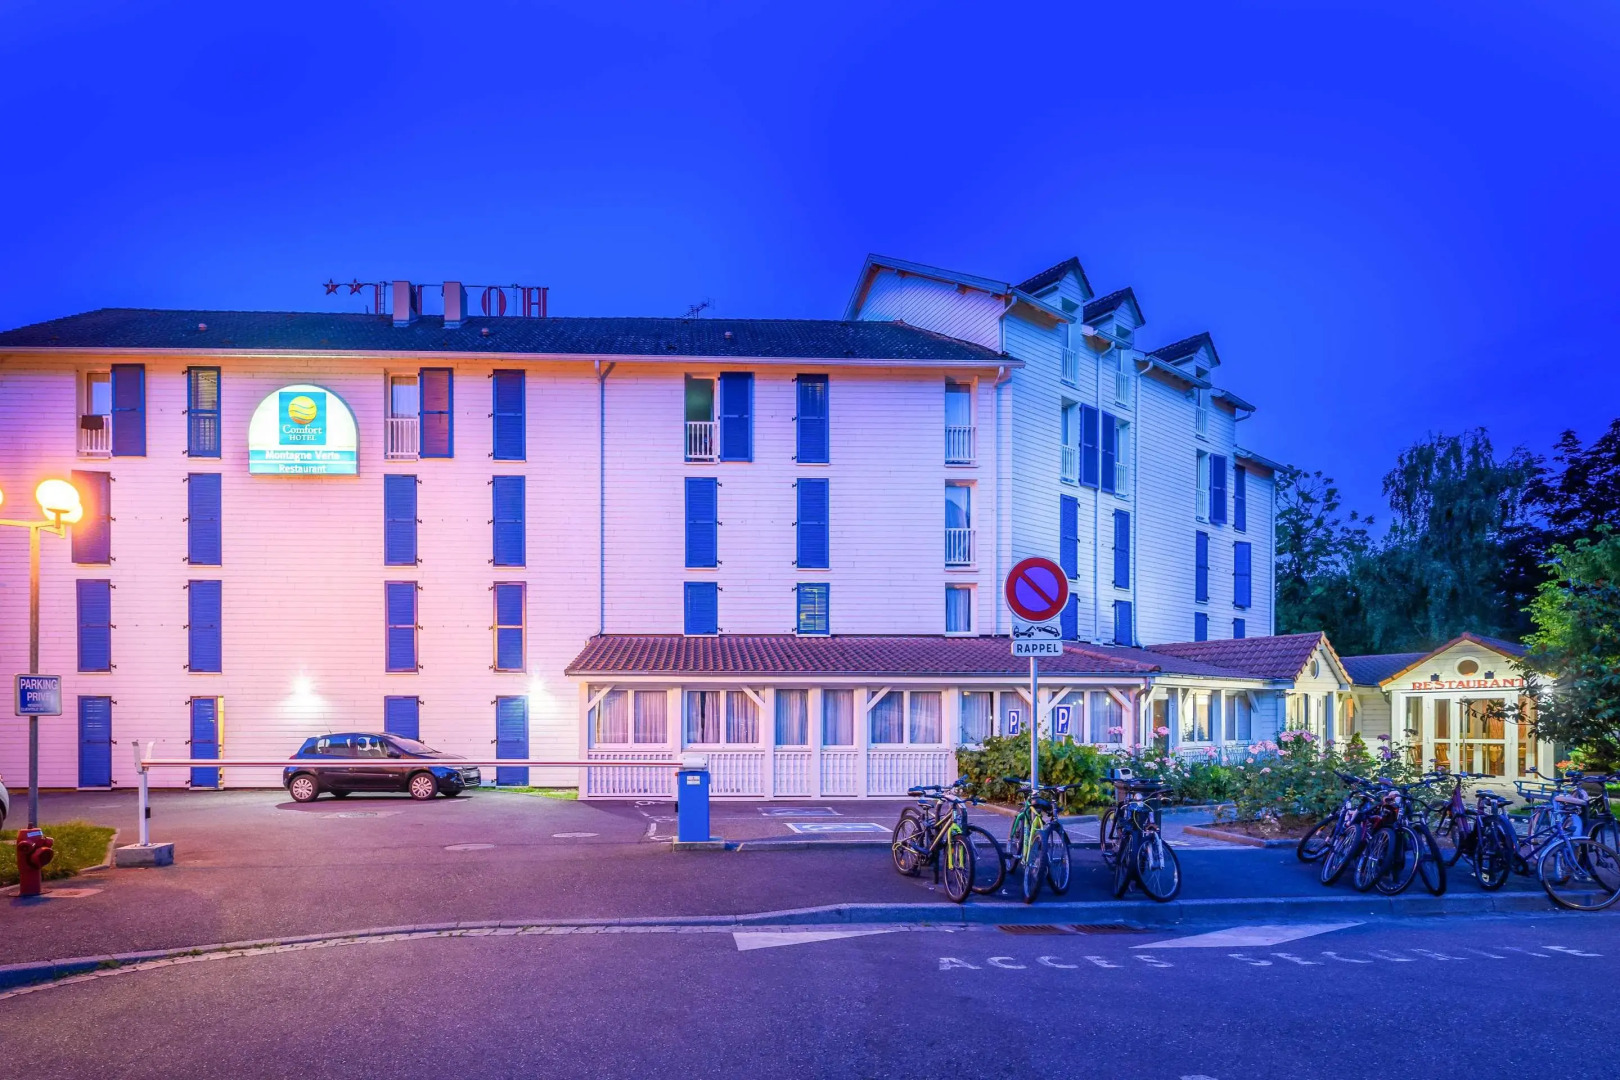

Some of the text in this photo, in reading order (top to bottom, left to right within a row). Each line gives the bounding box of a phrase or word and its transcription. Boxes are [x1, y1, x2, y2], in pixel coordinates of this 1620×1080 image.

[282, 424, 323, 434] Comfort
[265, 450, 340, 462] Montagne Verte
[278, 464, 327, 473] Restaurant
[1016, 643, 1059, 653] RAPPEL
[20, 679, 58, 690] PARKING
[1412, 678, 1525, 690] RESTAURANT
[938, 954, 1175, 970] ACCES
